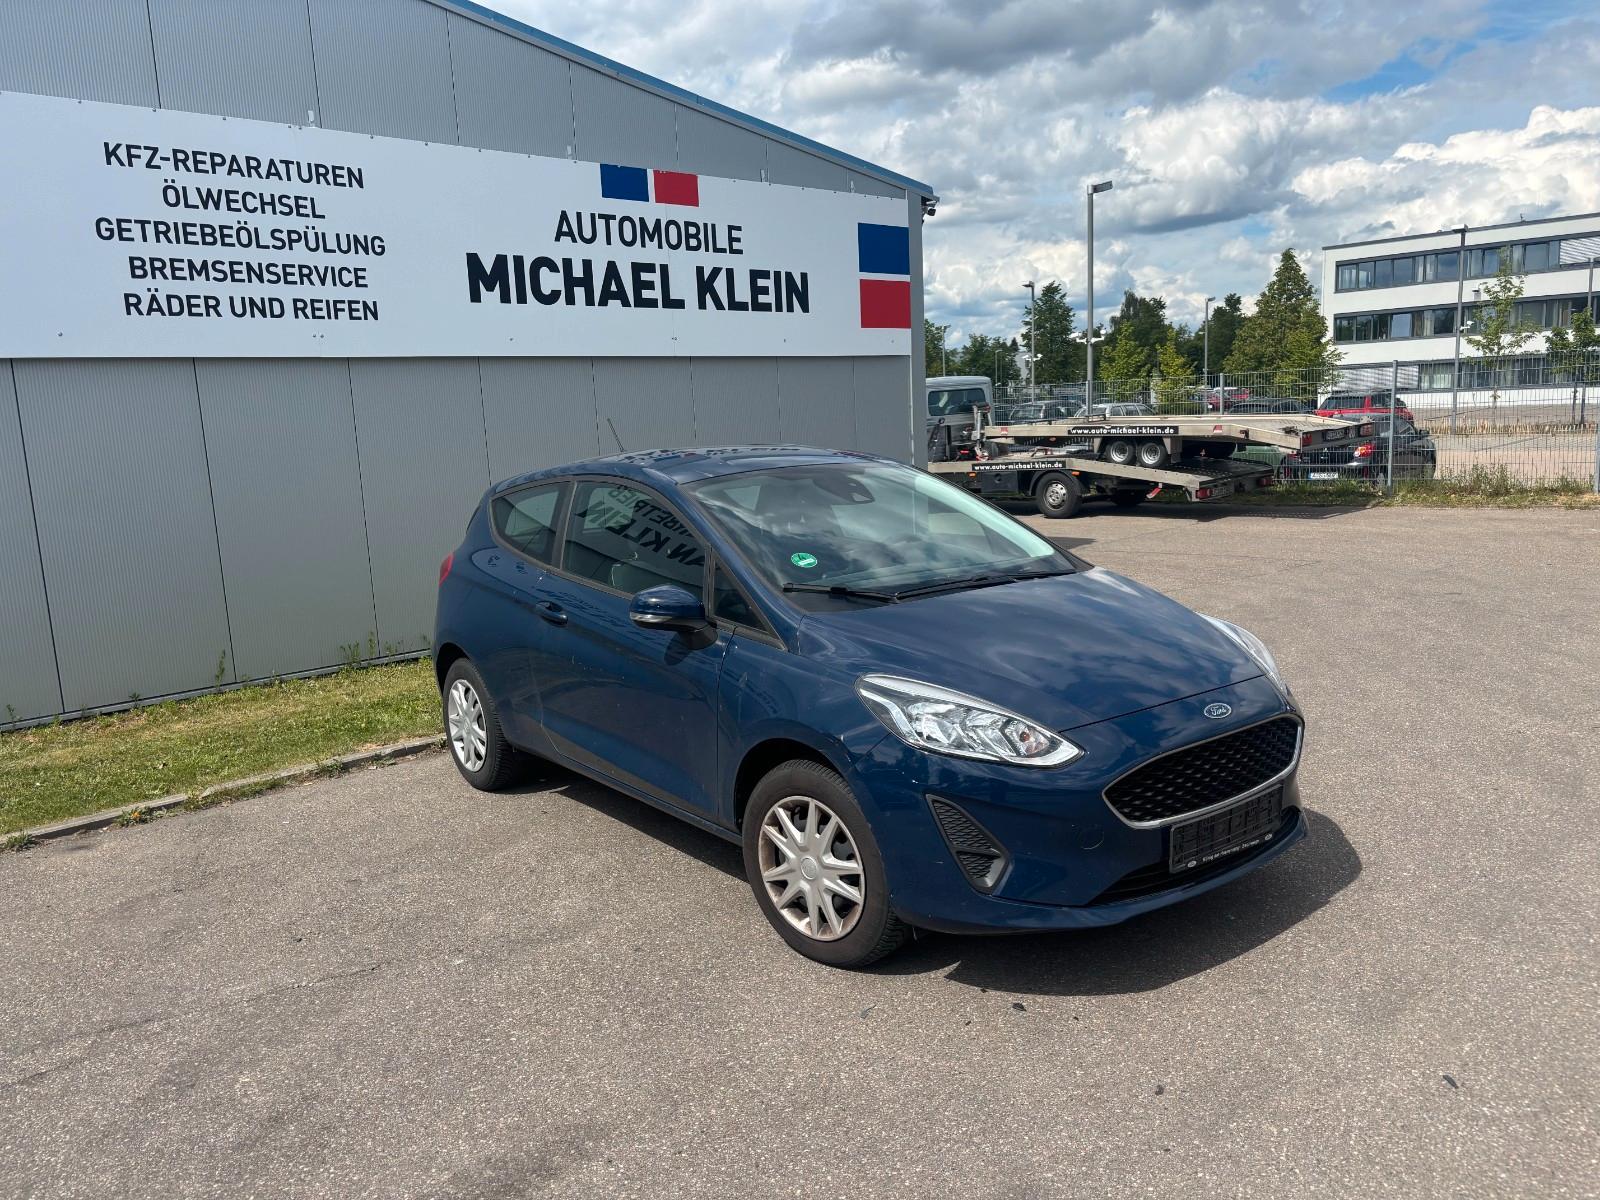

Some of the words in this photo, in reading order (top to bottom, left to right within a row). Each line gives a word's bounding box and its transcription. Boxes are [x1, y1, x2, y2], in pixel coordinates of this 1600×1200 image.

[103, 141, 364, 189] KFZ-REPARATUREN
[162, 178, 326, 220] ÖLWECHSEL
[95, 216, 386, 257] GETRIEBEÖLSPÜLUNG
[554, 209, 744, 255] AUTOMOBILE
[128, 255, 369, 288] BREMSENSERVICE
[465, 252, 686, 310] MICHAEL
[695, 265, 810, 314] KLEIN
[123, 287, 223, 318] RÄDER
[228, 295, 286, 319] UND
[292, 297, 379, 321] REIFEN
[1071, 426, 1175, 435] www.auto-michael-klein.de
[974, 461, 1063, 471] www.auto-michael-klein.de
